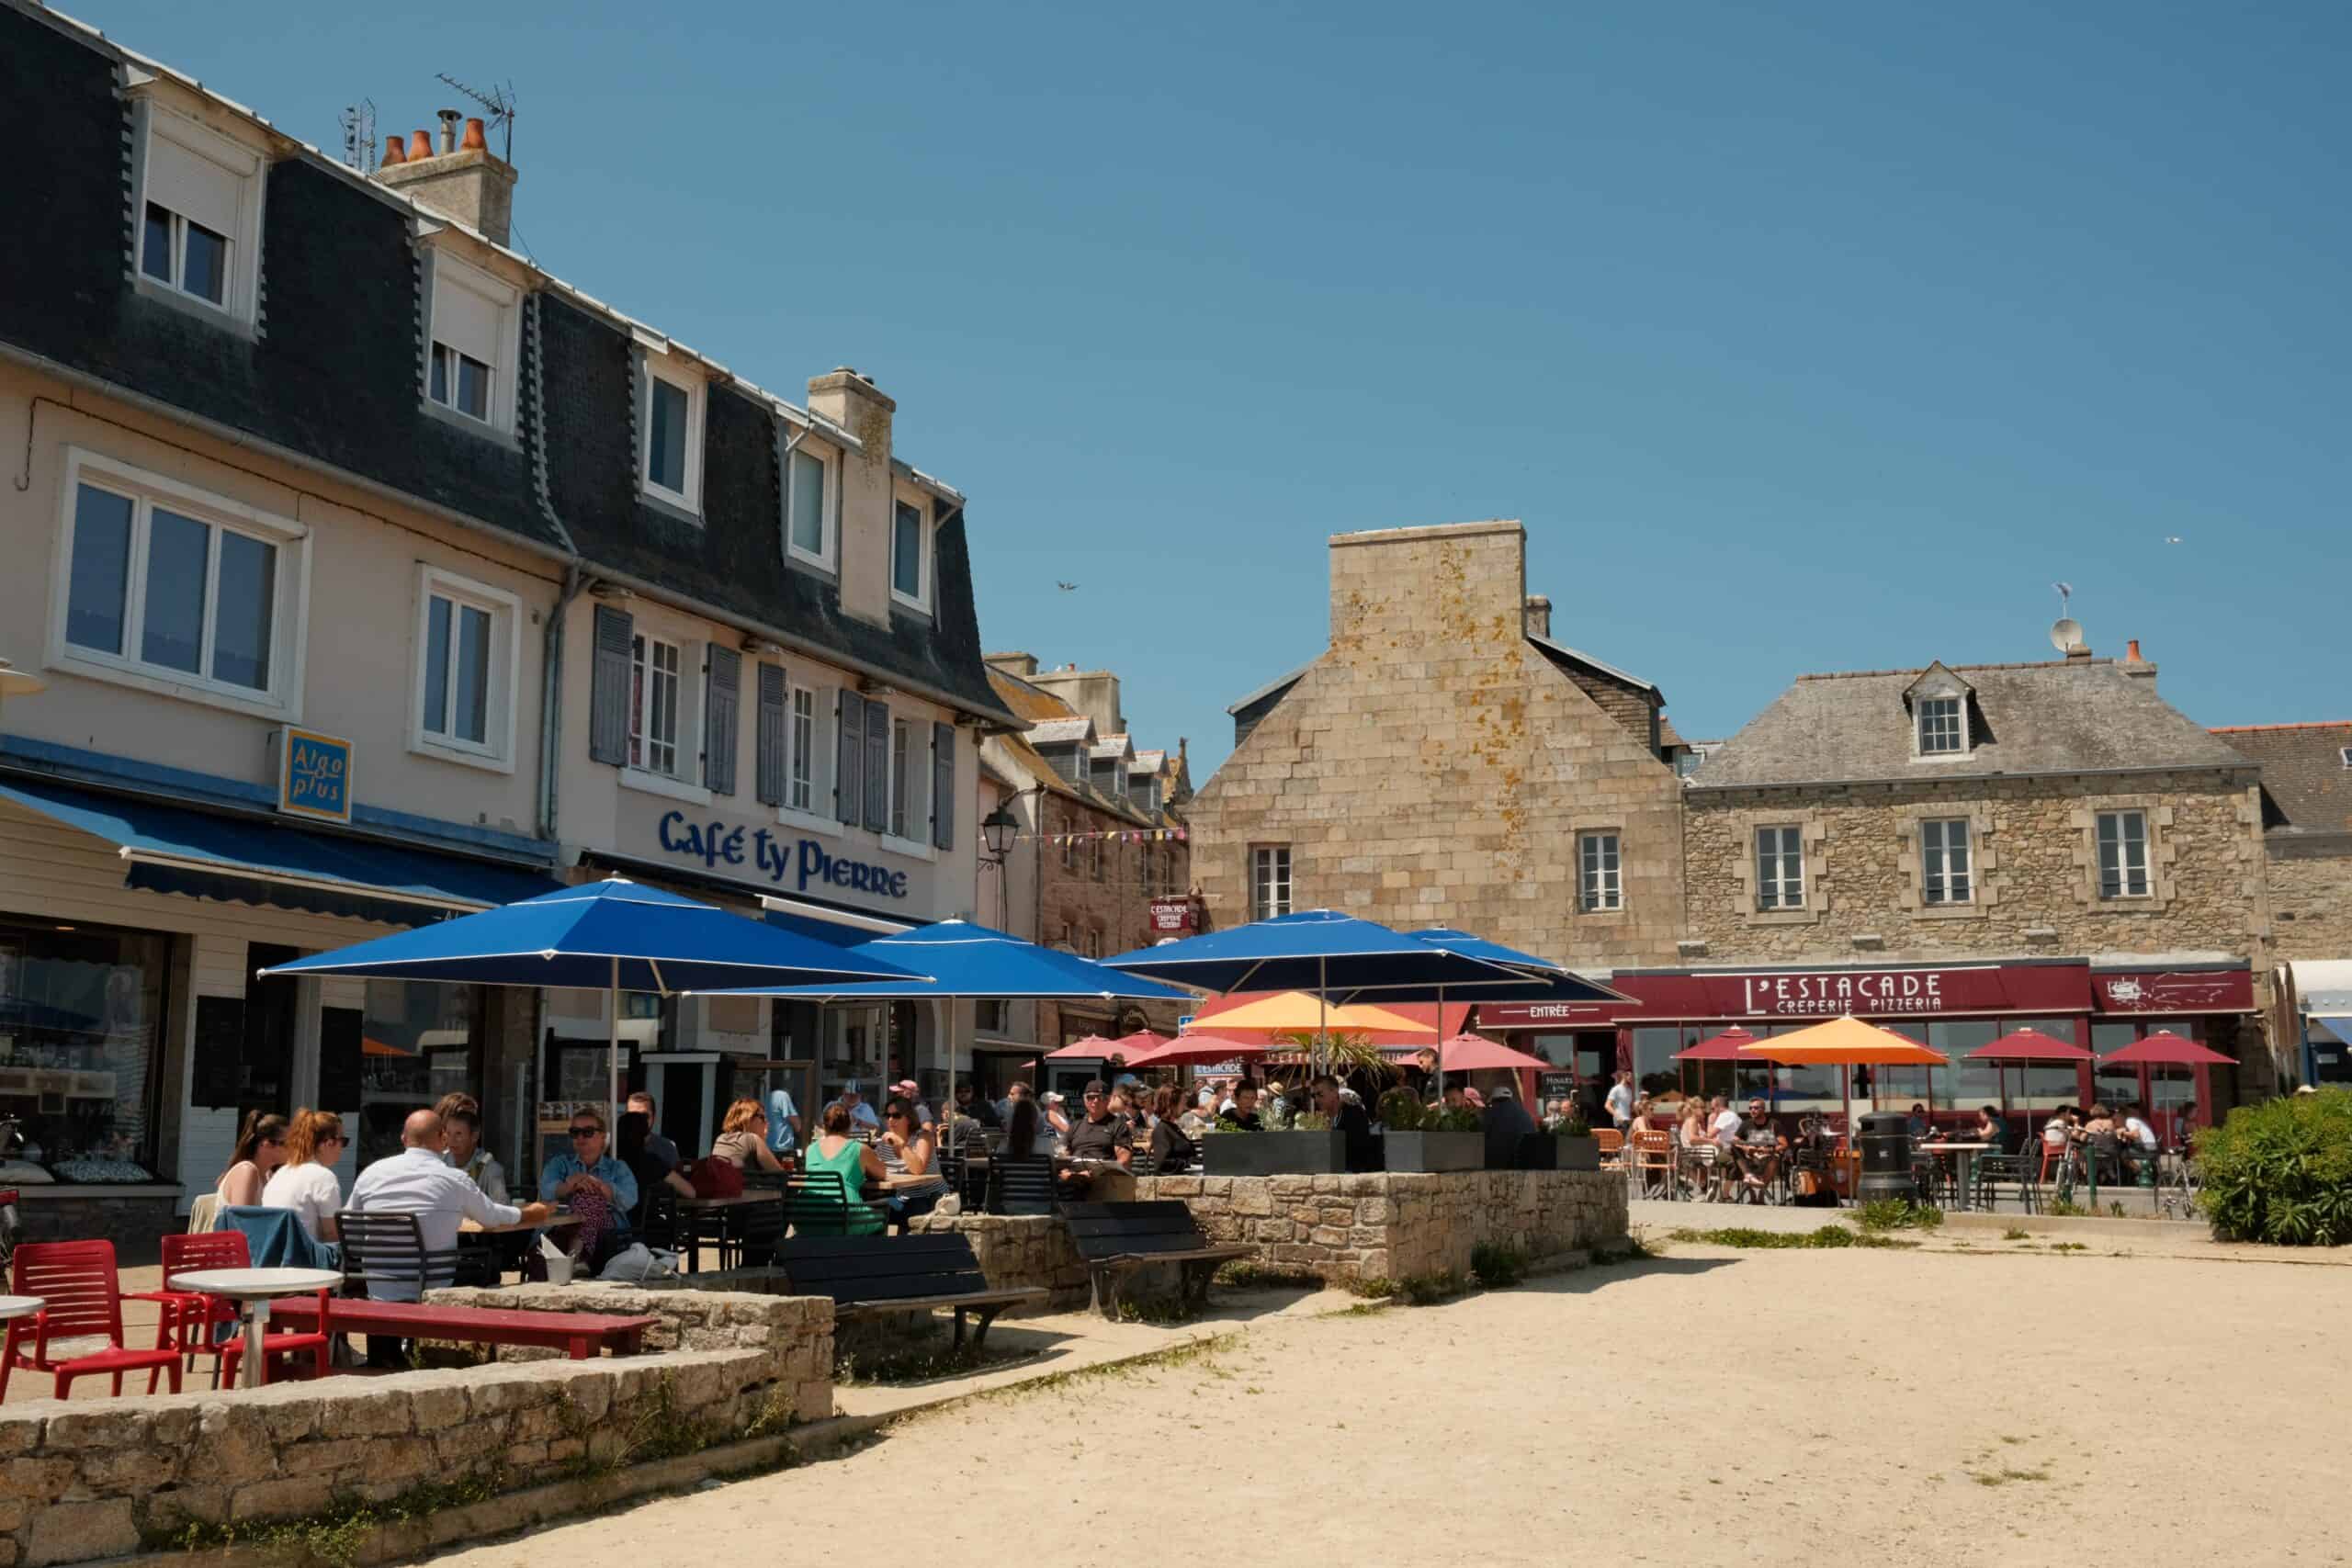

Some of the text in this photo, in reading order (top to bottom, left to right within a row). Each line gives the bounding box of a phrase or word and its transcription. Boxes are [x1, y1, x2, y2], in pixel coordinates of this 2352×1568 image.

[294, 744, 343, 779] Algo
[294, 777, 338, 800] plus
[659, 811, 745, 868] Café
[1746, 975, 1941, 1015] L'ESTACADE
[1777, 998, 1941, 1013] CREPERIE PIZZERIA
[1530, 1004, 1571, 1018] ENTRÉE
